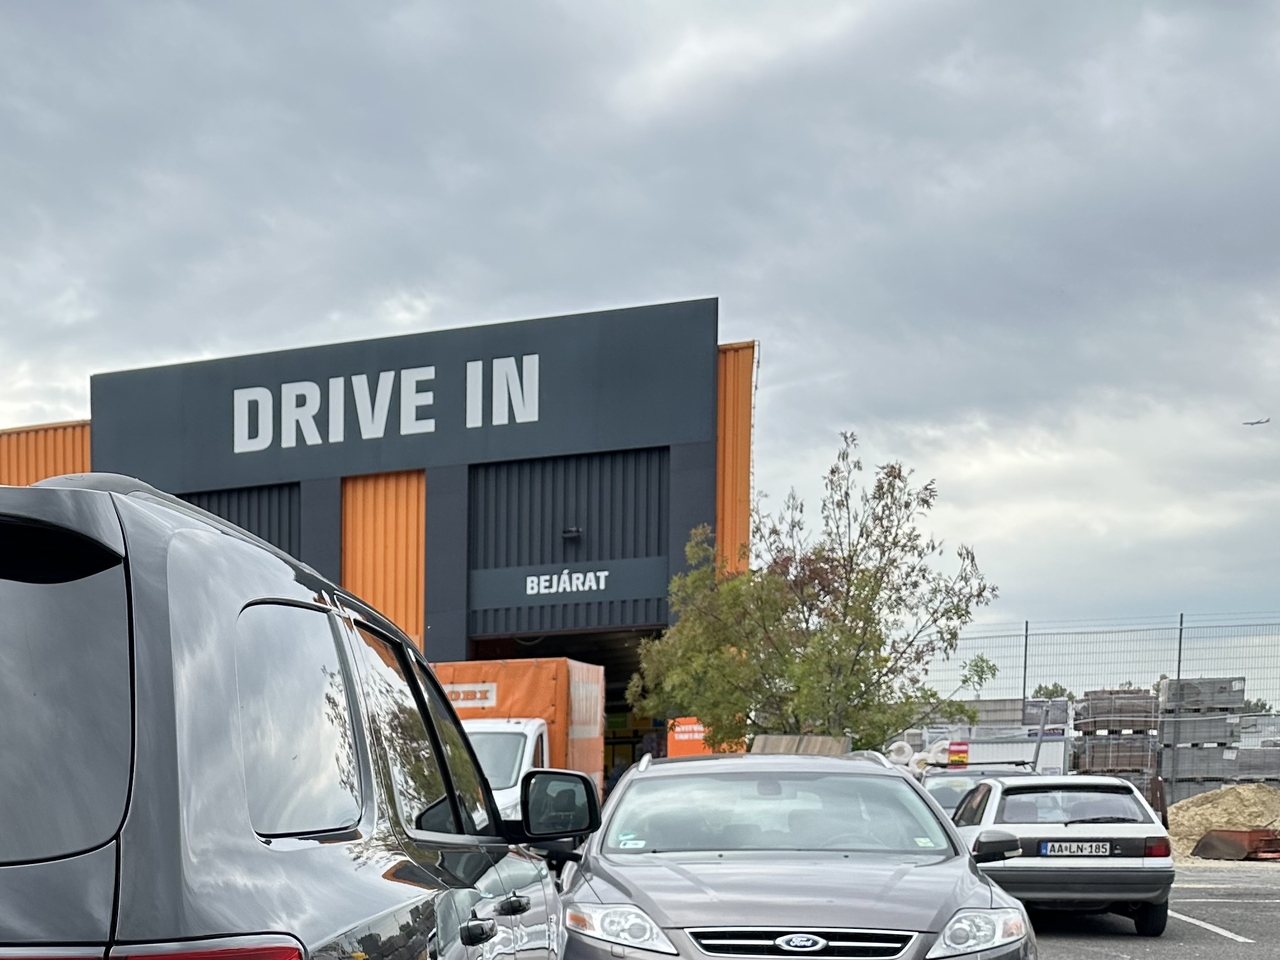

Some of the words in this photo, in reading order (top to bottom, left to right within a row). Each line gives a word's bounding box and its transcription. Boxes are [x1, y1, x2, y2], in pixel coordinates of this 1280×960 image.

[233, 366, 436, 453] DRIVE
[466, 354, 539, 428] IN
[526, 569, 609, 595] BEJÁRAT
[447, 689, 490, 701] OBI
